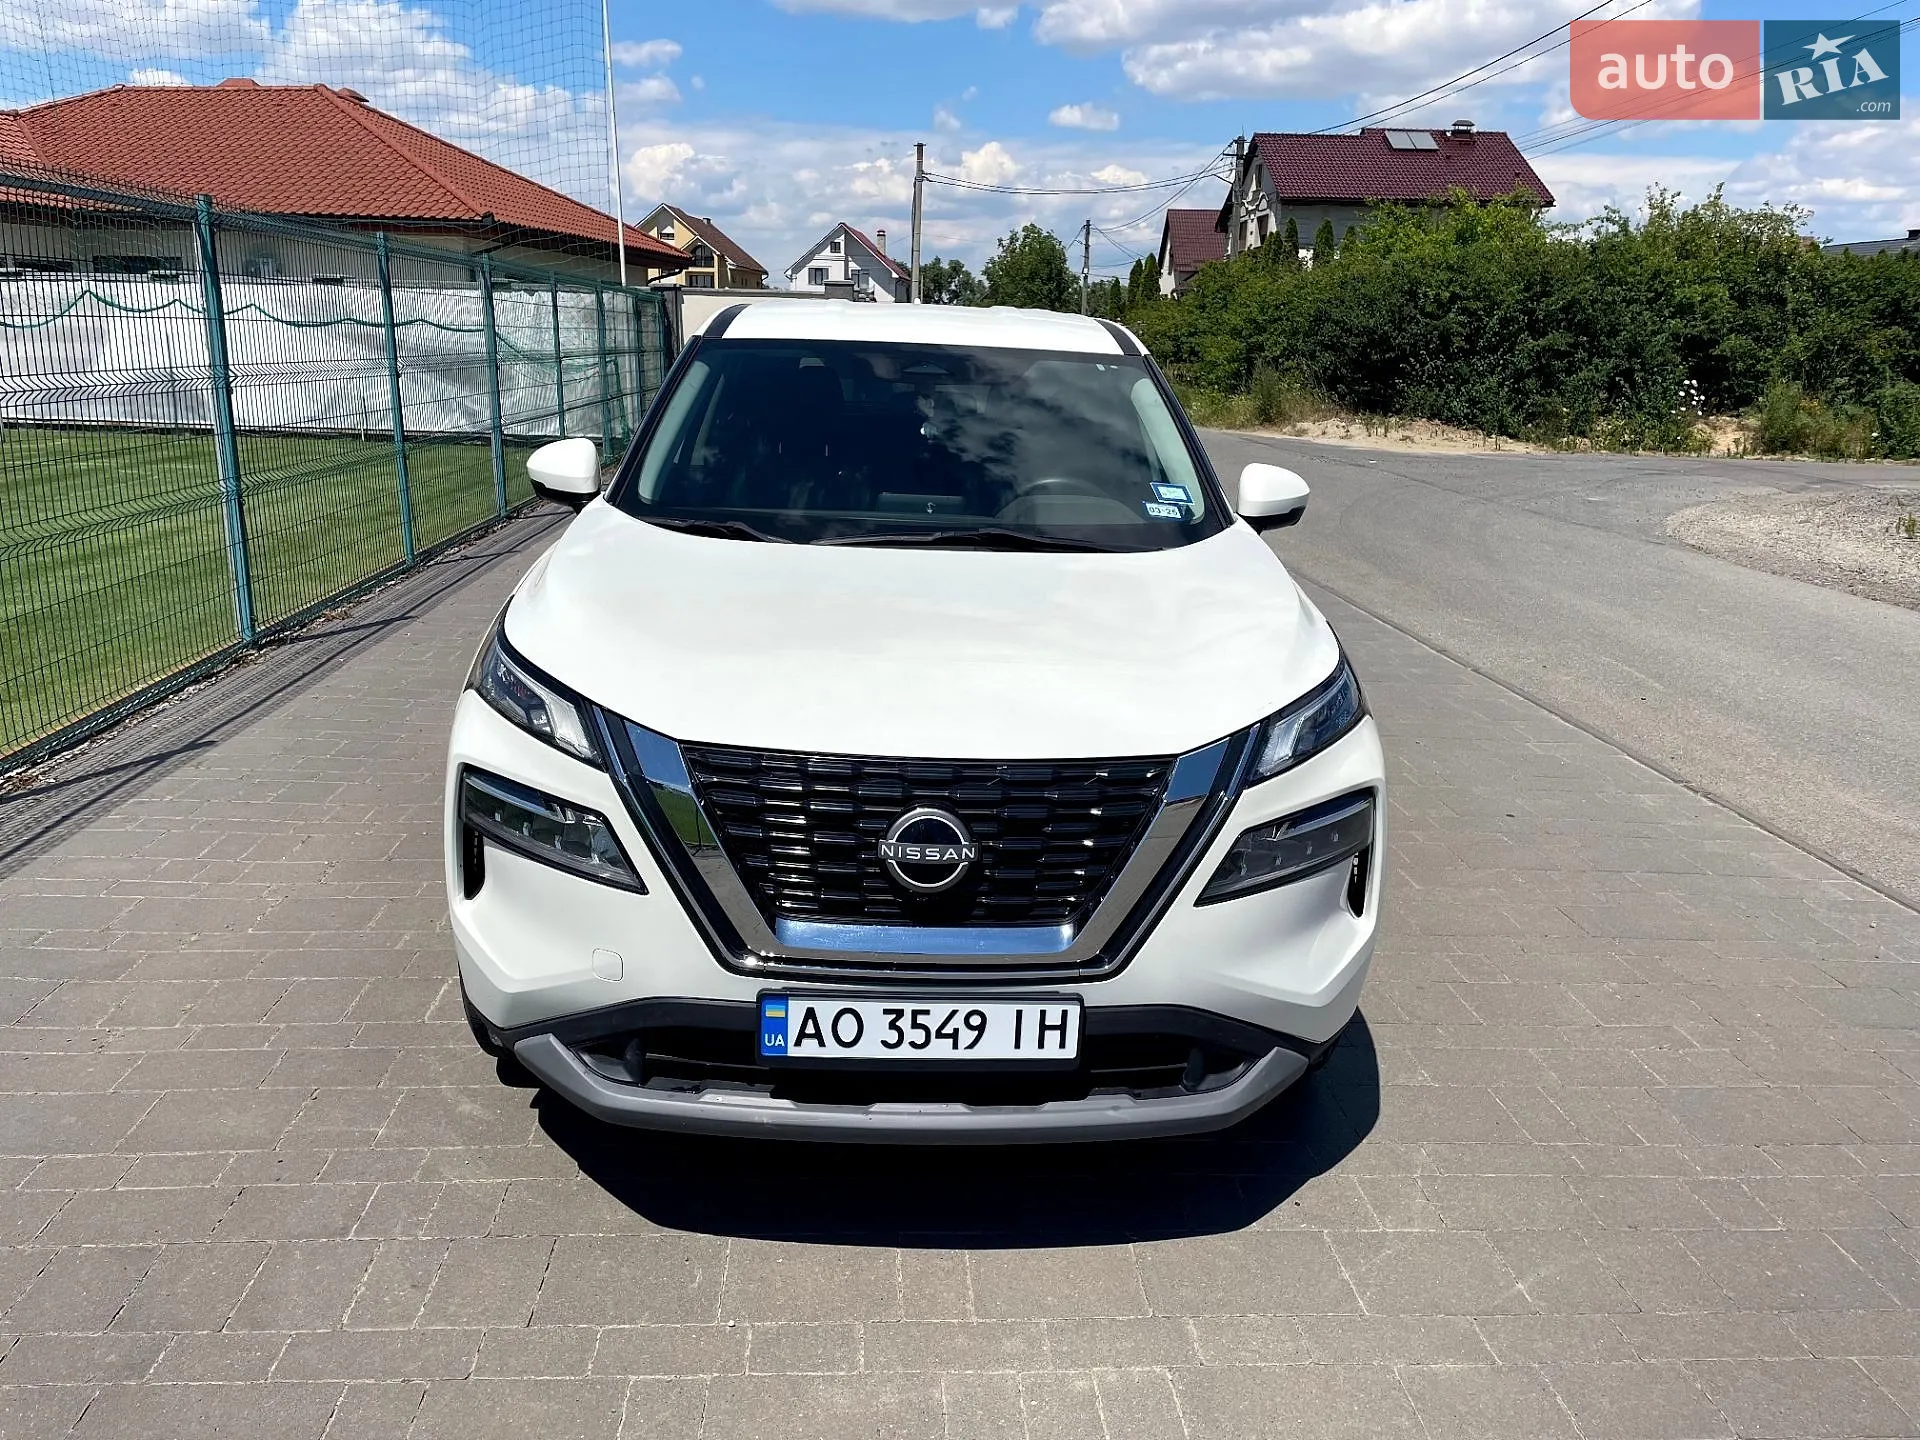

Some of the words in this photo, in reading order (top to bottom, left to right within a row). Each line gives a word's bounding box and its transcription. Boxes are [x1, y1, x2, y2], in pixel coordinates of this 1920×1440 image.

[881, 844, 975, 861] NISSAN
[793, 1006, 864, 1049] AO
[880, 1008, 988, 1050] 3549
[1013, 1009, 1069, 1050] IH
[764, 1033, 785, 1047] UA
